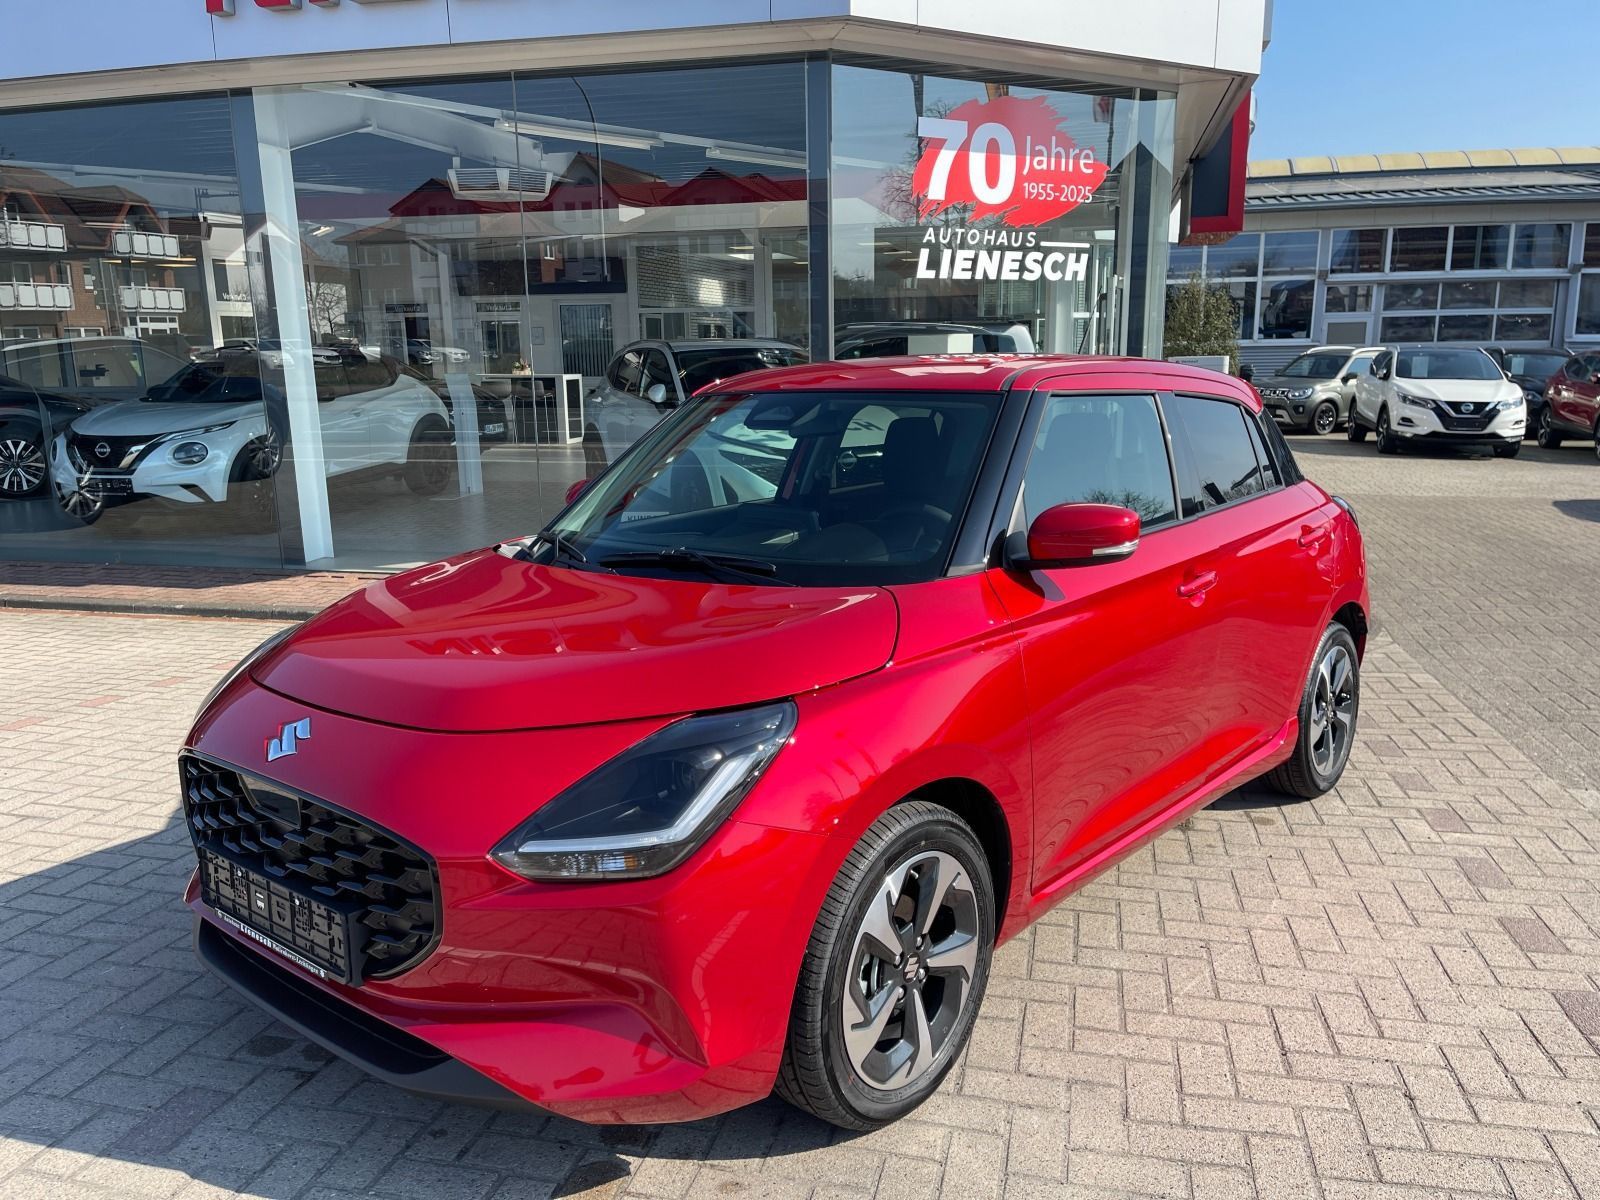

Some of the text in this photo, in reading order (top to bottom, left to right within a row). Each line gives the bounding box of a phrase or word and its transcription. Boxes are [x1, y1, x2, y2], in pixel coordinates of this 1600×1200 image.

[918, 116, 1094, 205] 70 Jahre
[1023, 182, 1093, 204] 1955-2025
[922, 227, 1037, 247] AUTOHAUS
[916, 247, 1089, 281] LIENESCH
[240, 923, 272, 949] Lienesch
